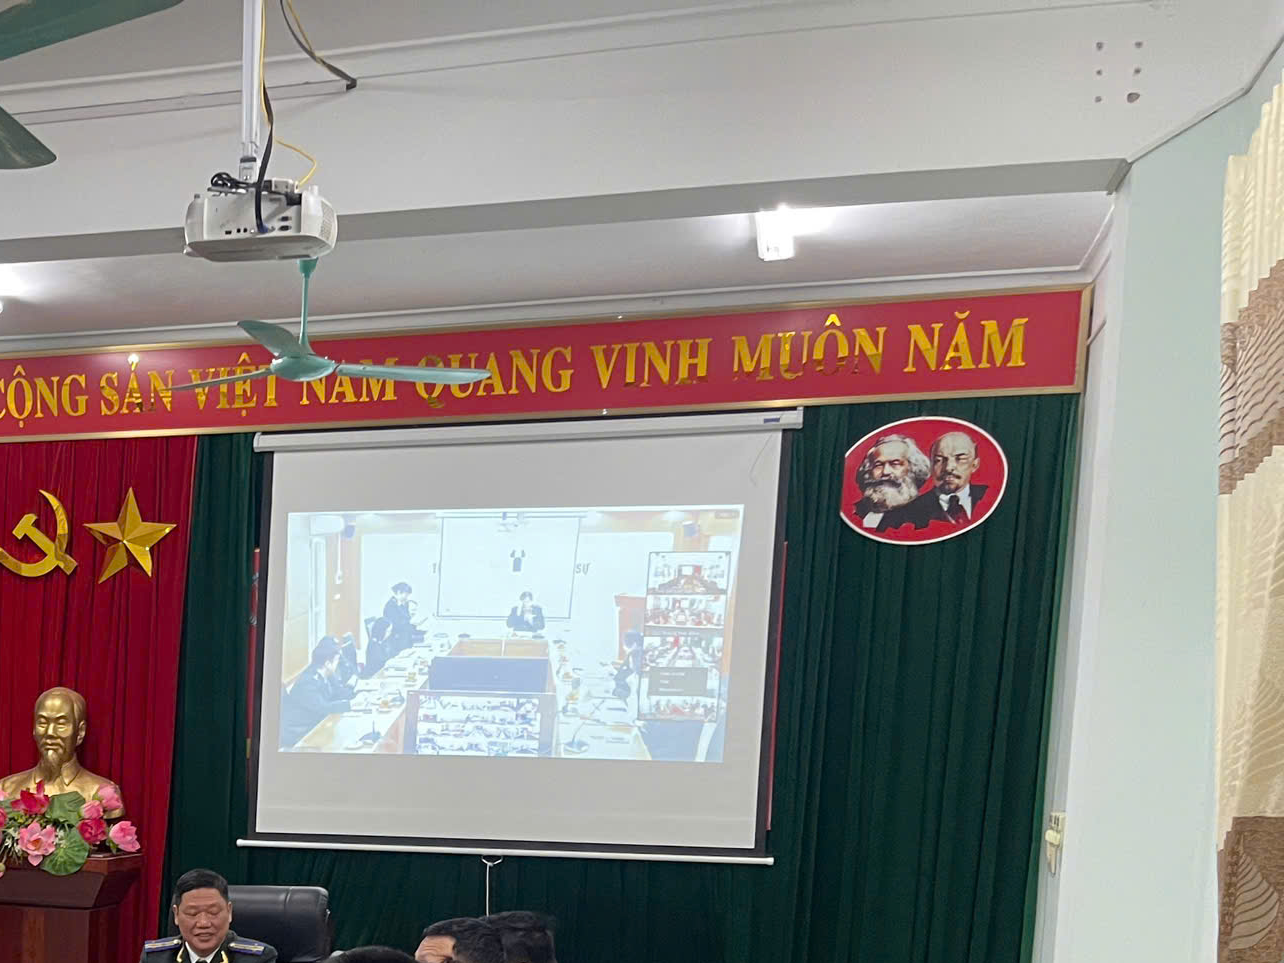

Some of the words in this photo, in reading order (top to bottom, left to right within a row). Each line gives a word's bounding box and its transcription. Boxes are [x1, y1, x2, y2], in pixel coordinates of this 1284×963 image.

[100, 354, 176, 416] SẢN
[188, 352, 278, 416] VIỆT
[300, 357, 399, 405] NAM
[416, 346, 574, 408] QUANG
[590, 337, 713, 390] VINH
[732, 313, 888, 382] MUÔN
[903, 310, 1029, 372] NĂM
